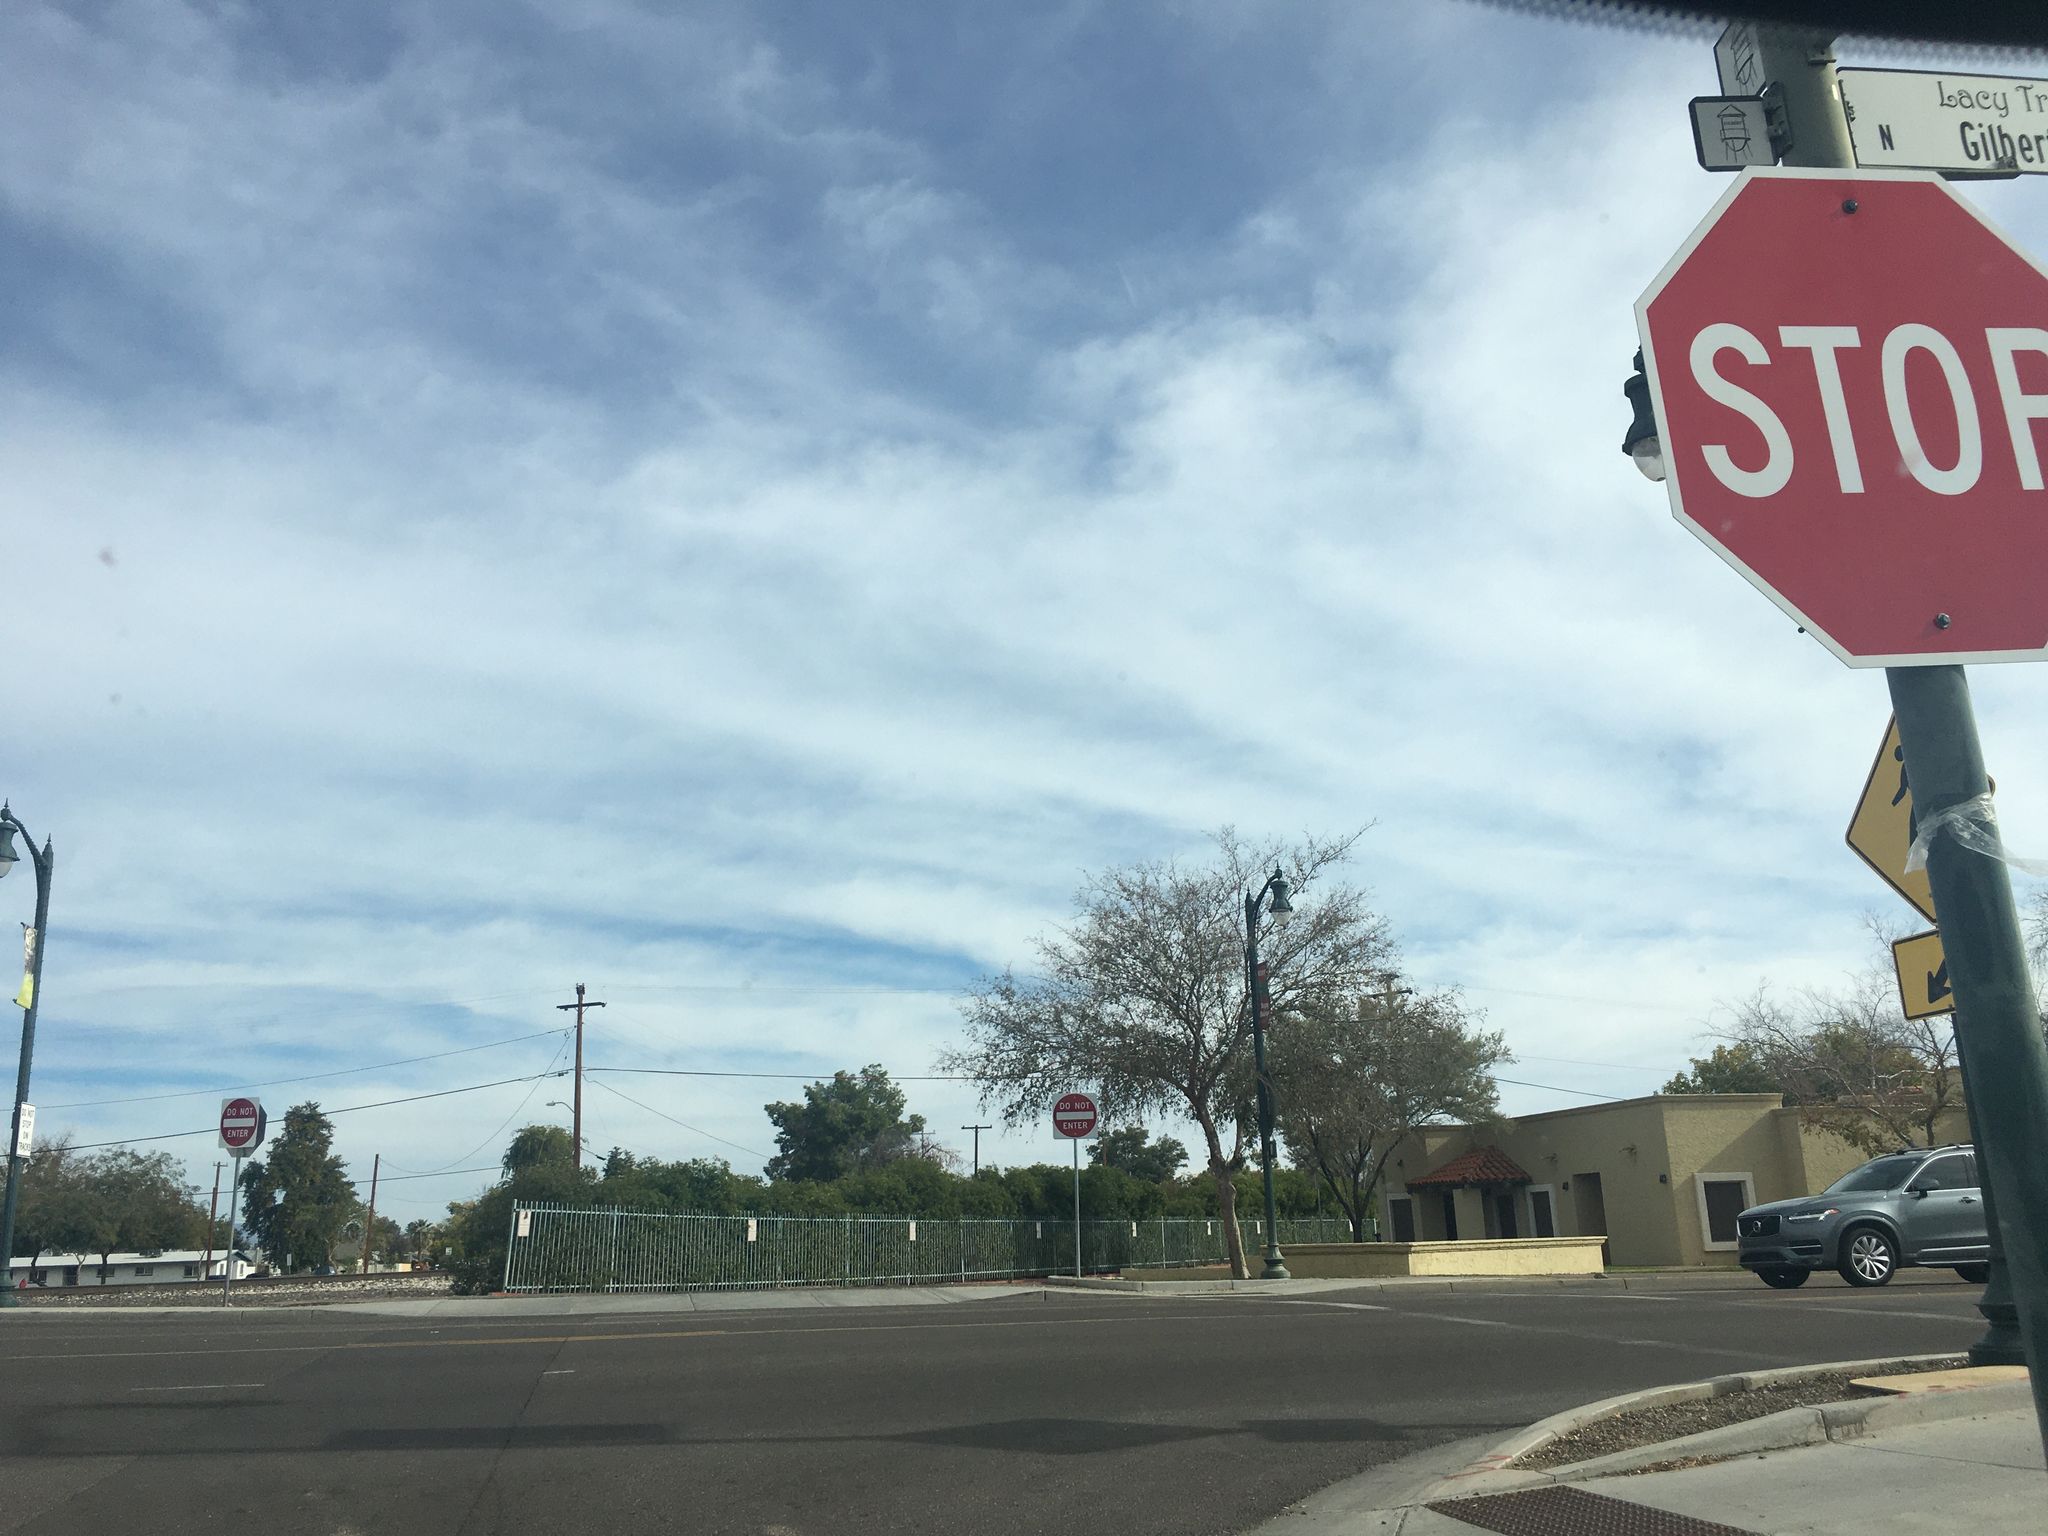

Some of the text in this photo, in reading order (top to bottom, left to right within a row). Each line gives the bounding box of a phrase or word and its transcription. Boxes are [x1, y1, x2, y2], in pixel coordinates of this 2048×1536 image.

[1937, 81, 2009, 118] Lacy
[1878, 121, 2048, 163] N Gilber
[1689, 322, 2048, 498] STOP
[227, 1107, 253, 1116] DO NOT
[227, 1129, 248, 1137] ENTER
[1063, 1121, 1088, 1129] ENTER
